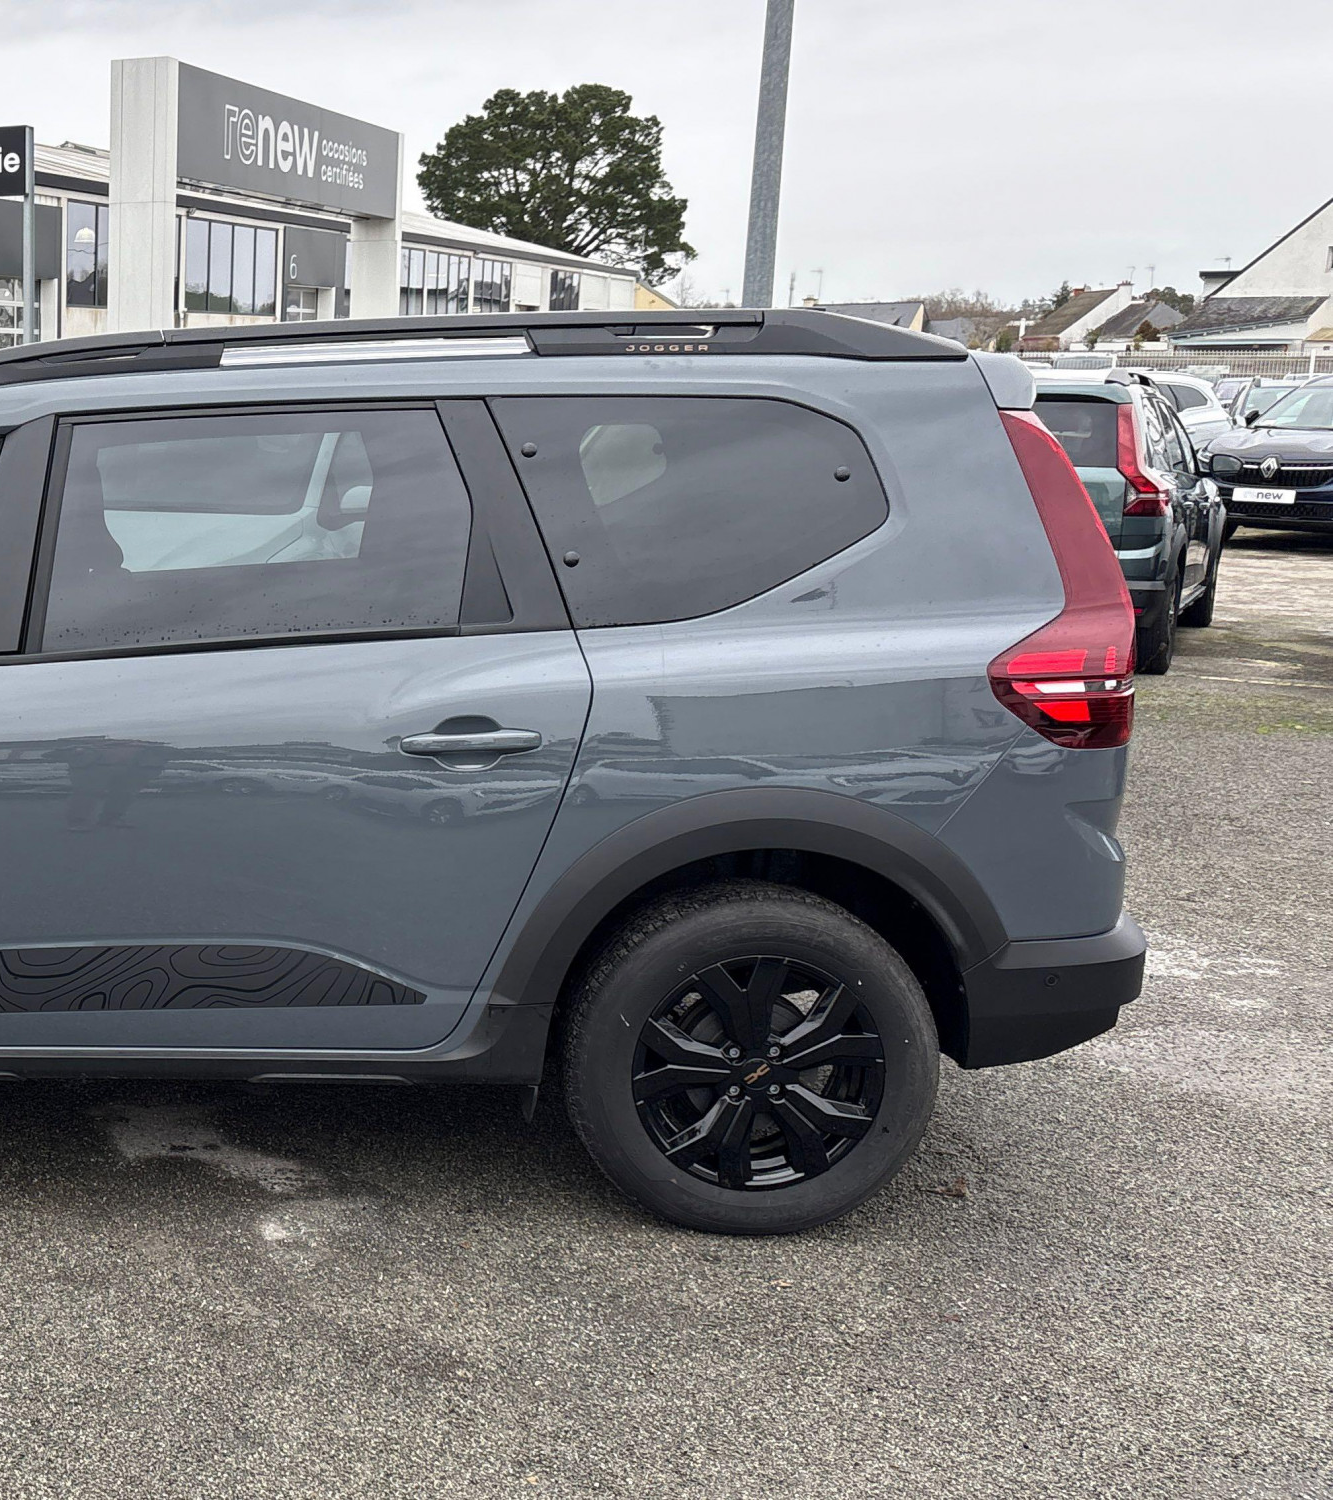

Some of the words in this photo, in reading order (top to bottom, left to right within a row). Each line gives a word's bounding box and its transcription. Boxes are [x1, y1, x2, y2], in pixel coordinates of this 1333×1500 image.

[224, 103, 319, 178] renew
[321, 138, 368, 166] occasions
[320, 164, 364, 190] certifiées
[289, 253, 298, 280] 6
[625, 344, 709, 352] JOGGER
